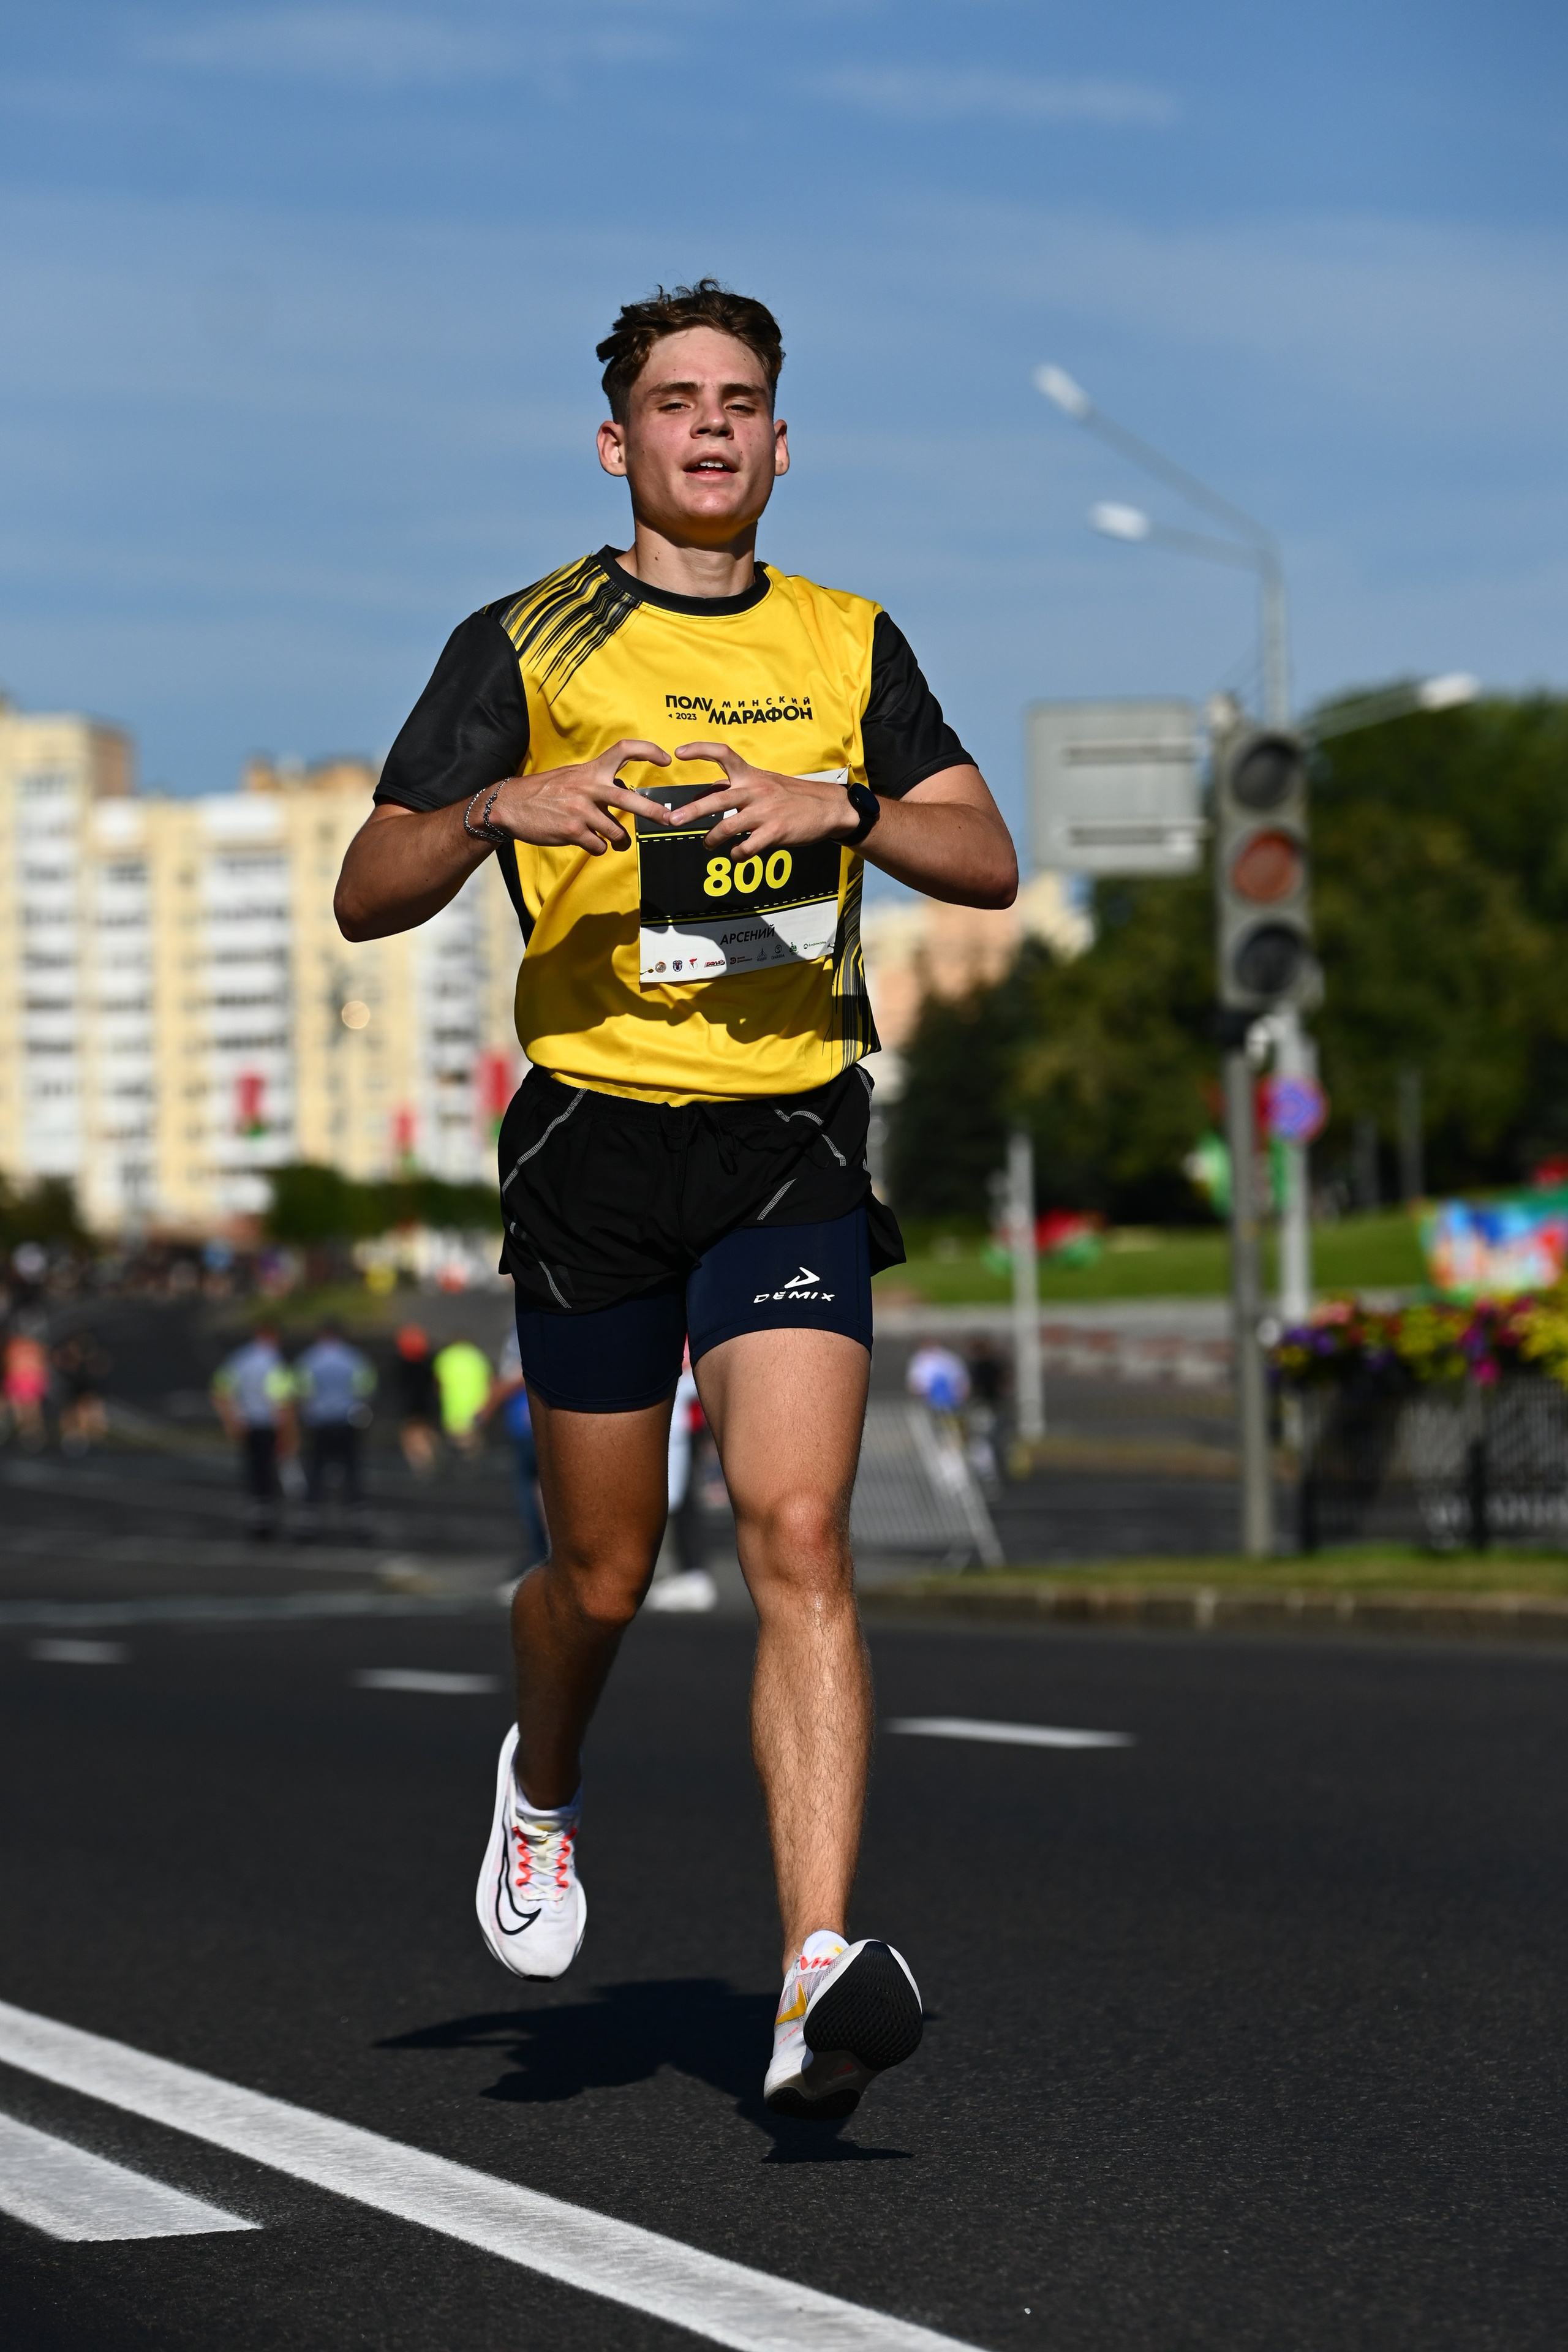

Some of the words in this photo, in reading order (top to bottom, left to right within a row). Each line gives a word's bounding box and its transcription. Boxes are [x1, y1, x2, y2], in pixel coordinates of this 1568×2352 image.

[665, 695, 713, 712] ПОЛУ
[722, 696, 810, 708] МИНСКИЙ
[708, 705, 813, 725] МАРАФОН
[703, 850, 793, 897] 800
[720, 924, 775, 946] АРСЕНИЙ
[753, 1291, 835, 1303] DEMIX
